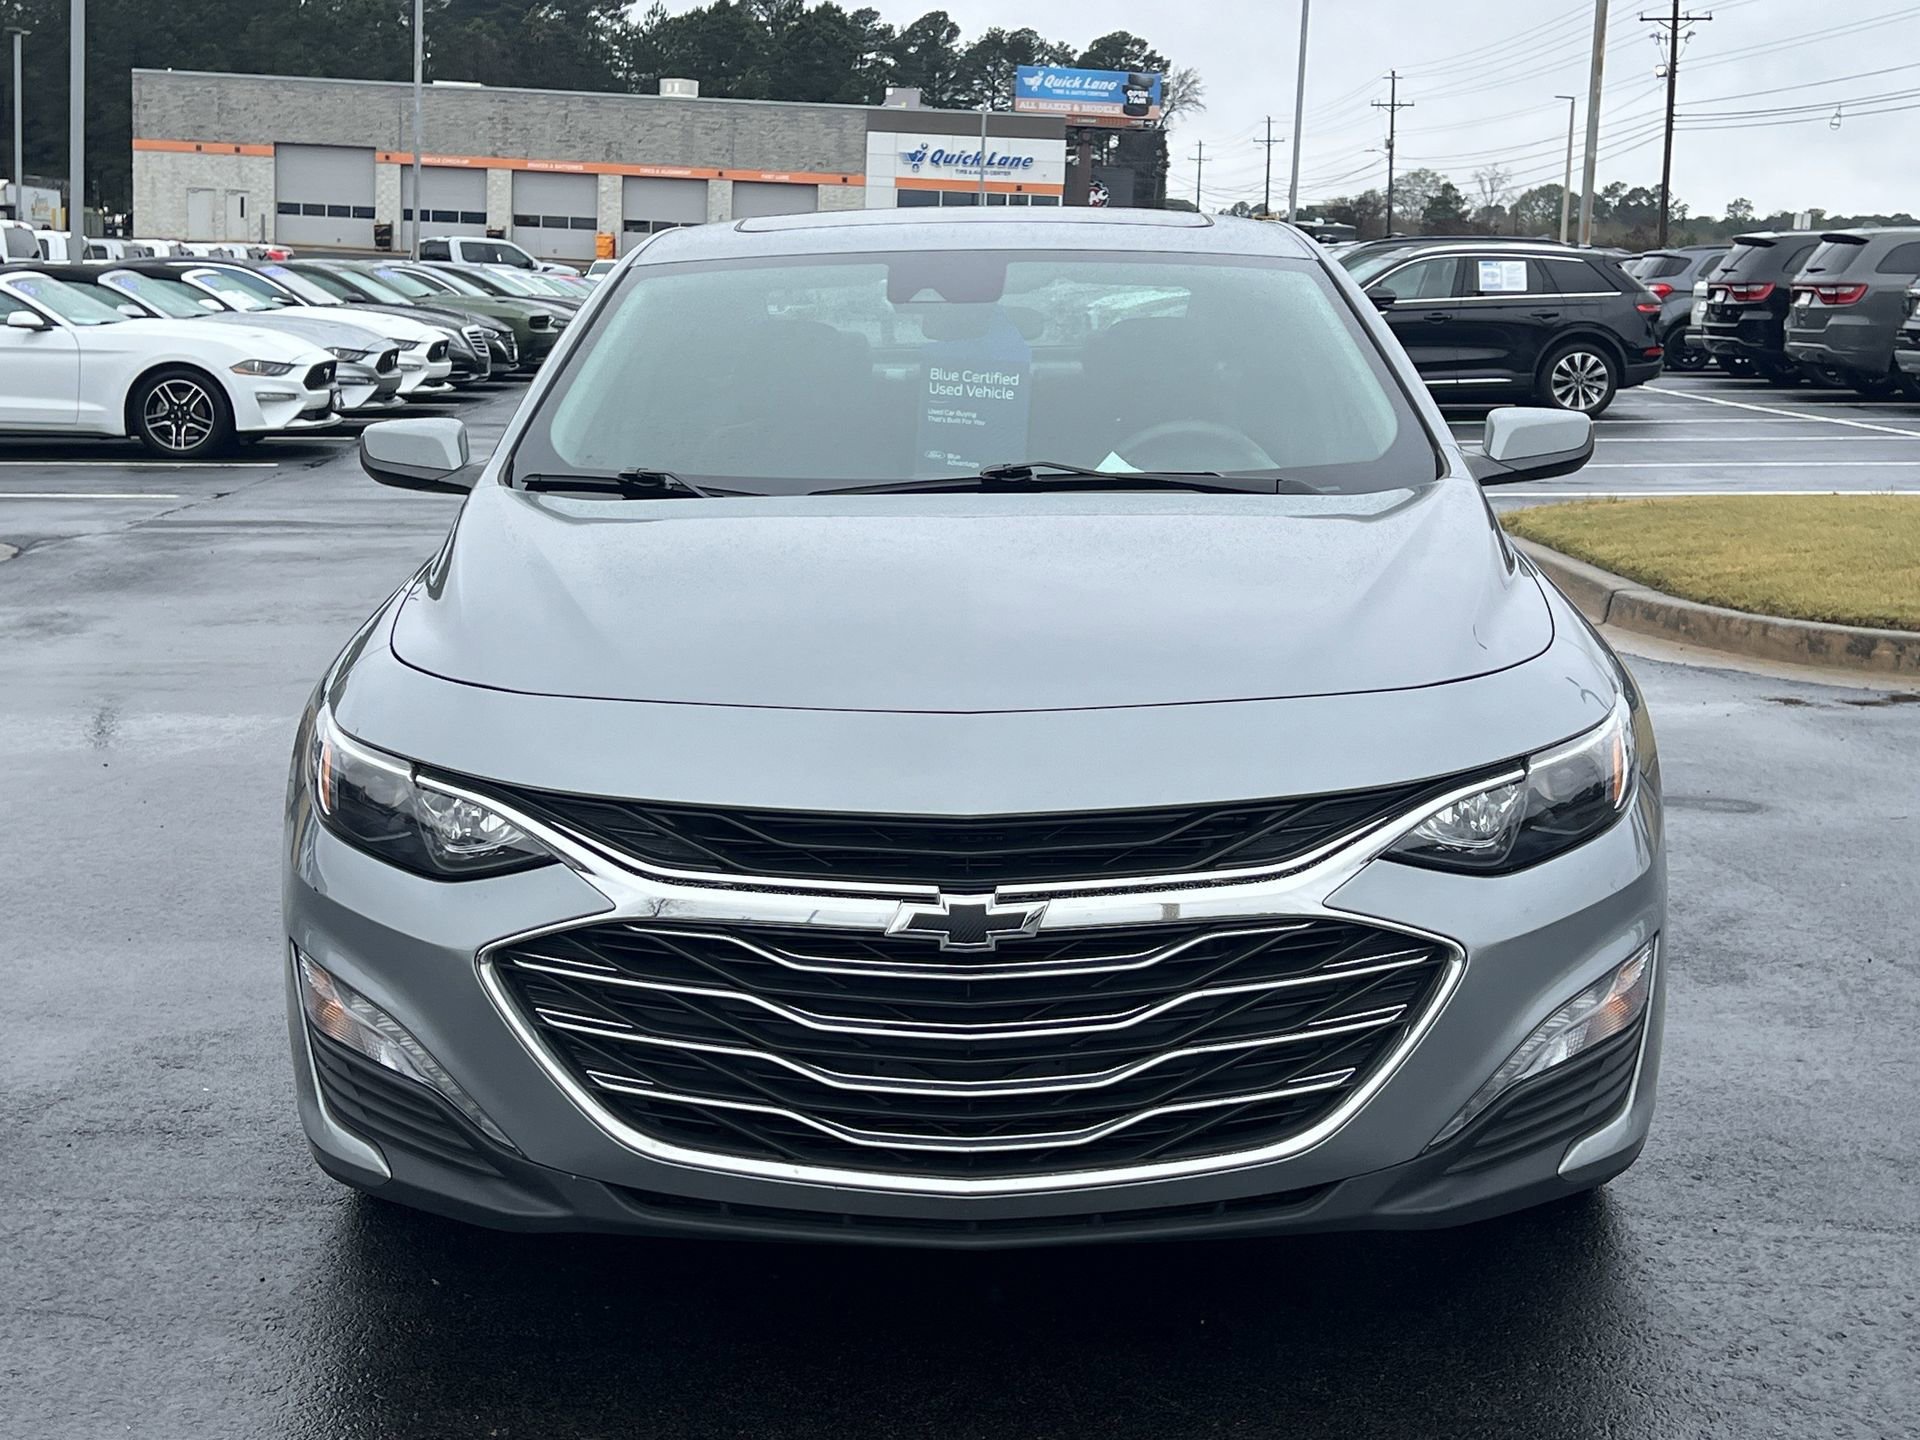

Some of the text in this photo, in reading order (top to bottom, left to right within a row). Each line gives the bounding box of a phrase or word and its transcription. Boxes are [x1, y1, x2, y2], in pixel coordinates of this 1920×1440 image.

[1044, 74, 1118, 90] Quick Lane
[1127, 90, 1149, 98] OPEN
[1019, 101, 1039, 110] ALL
[1039, 102, 1072, 112] MAKES
[1081, 104, 1121, 114] MODELS
[930, 149, 1034, 169] Quick Lane
[930, 367, 1020, 386] Blue Certified
[929, 382, 1015, 400] Used Vehicle
